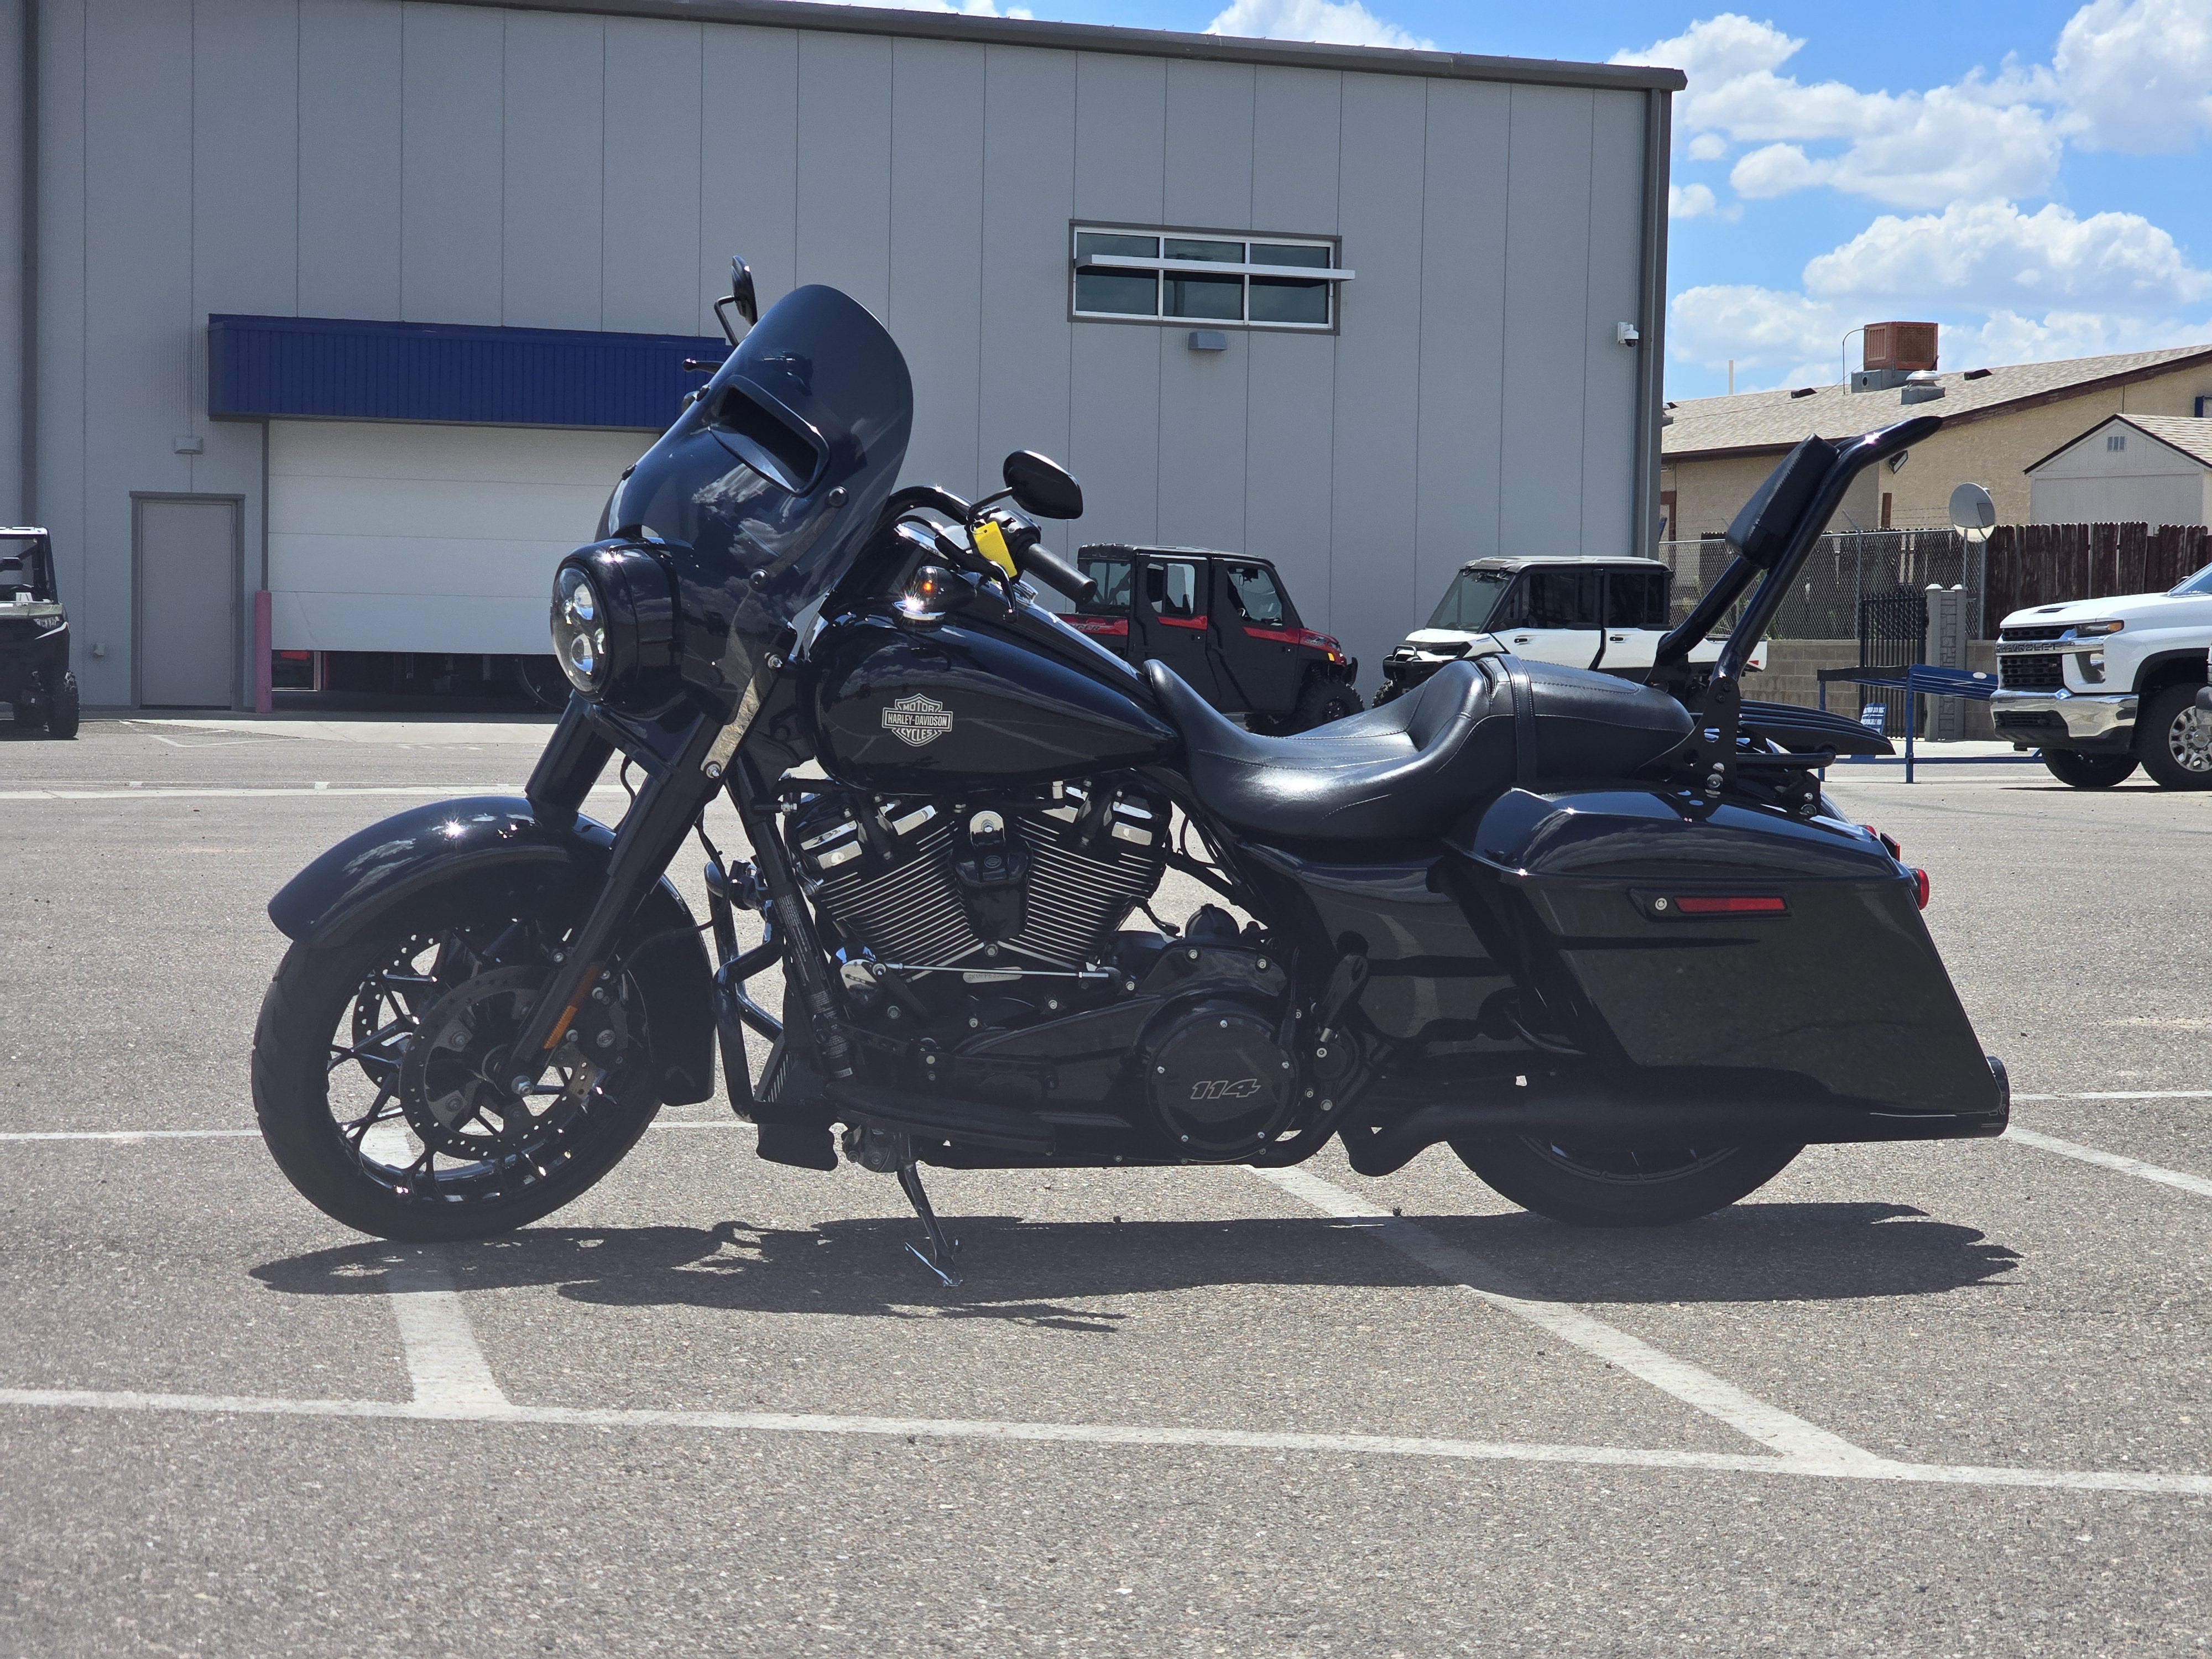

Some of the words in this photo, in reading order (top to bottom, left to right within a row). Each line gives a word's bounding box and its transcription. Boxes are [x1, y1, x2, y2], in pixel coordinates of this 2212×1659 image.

[1996, 643, 2058, 653] CHEVROLET
[903, 700, 935, 712] MOTOR
[888, 713, 947, 727] HARLEY-DAVIDSON
[901, 728, 933, 742] CYCLES
[1190, 1078, 1261, 1100] 114
